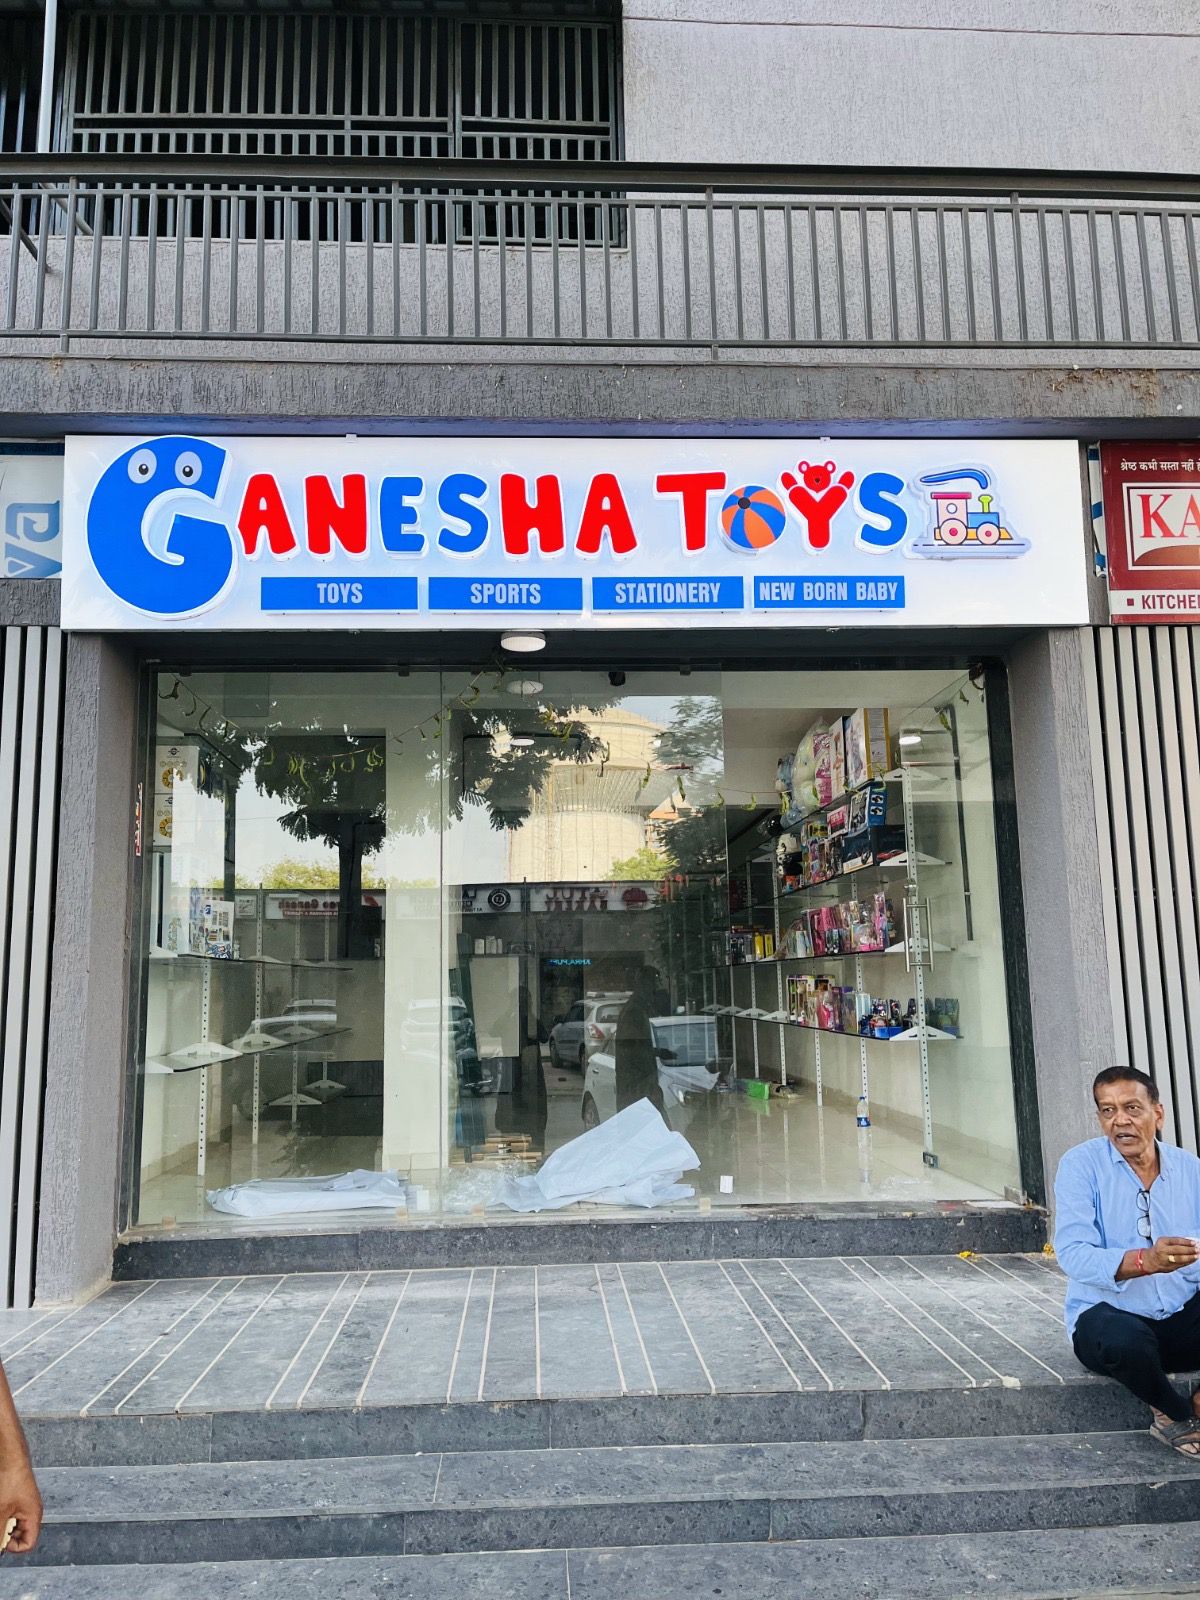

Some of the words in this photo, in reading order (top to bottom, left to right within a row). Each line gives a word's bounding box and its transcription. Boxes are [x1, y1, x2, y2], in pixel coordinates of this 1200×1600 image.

[1120, 458, 1137, 471] श्रेष्ठ
[1139, 458, 1158, 471] कभी
[1160, 461, 1179, 471] सस्ता
[87, 435, 638, 614] GANESHA
[656, 461, 908, 552] TOYS
[316, 582, 363, 604] TOYS
[470, 583, 541, 604] SPORTS
[615, 582, 721, 604] STATIONERY
[759, 582, 795, 601] NEW
[803, 582, 848, 600] BORN
[856, 582, 898, 600] BABY
[1142, 594, 1200, 610] KITCHE
